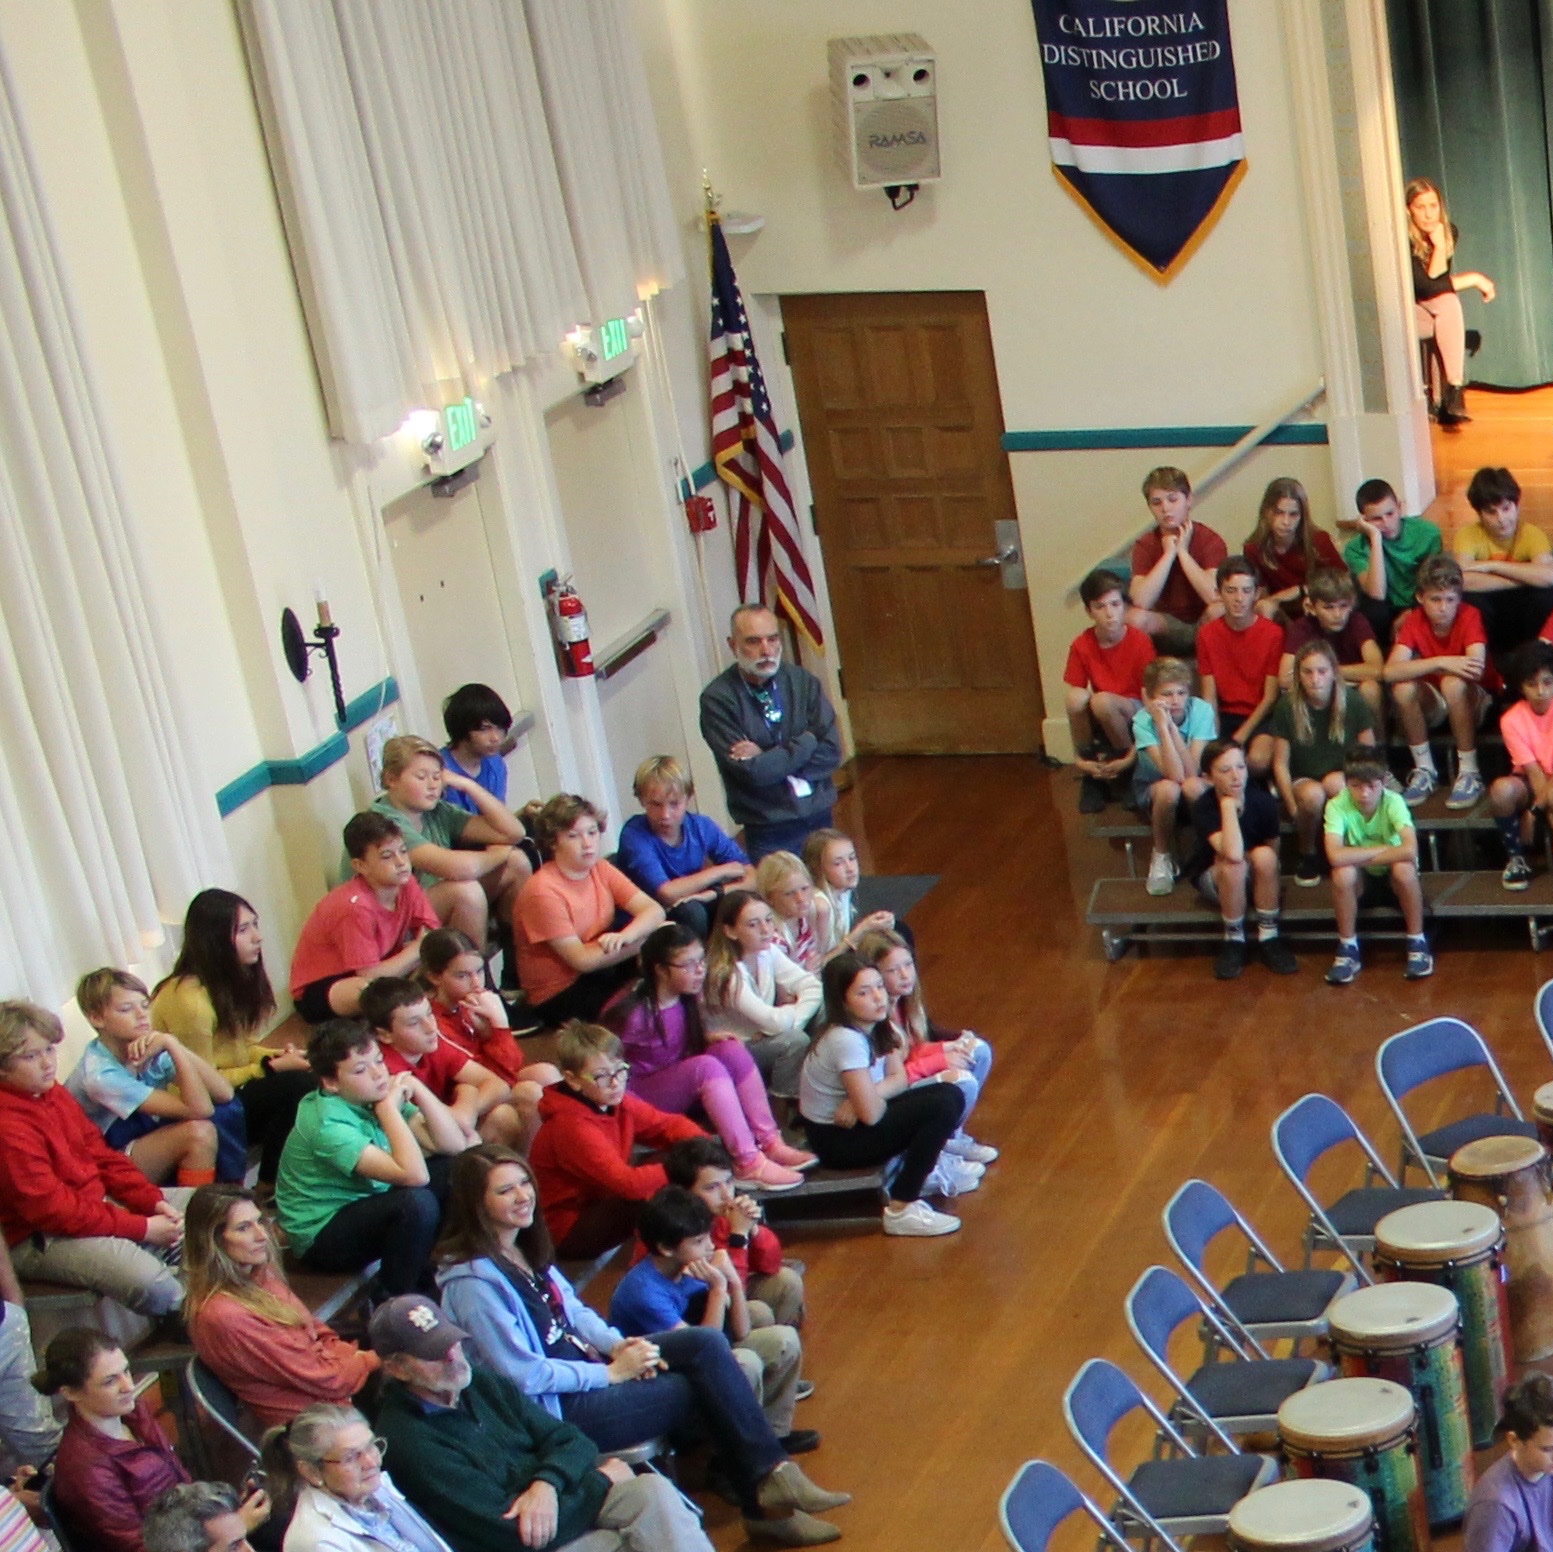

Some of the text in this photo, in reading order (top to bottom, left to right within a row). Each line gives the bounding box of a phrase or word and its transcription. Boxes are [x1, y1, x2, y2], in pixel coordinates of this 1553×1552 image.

[1058, 12, 1205, 38] CALIFORNIA
[1043, 40, 1221, 69] DISTINGUISHED
[1090, 78, 1187, 101] SCHOOL
[869, 130, 927, 148] RAMSA
[600, 318, 628, 362] EXIT
[445, 396, 477, 451] EXIT
